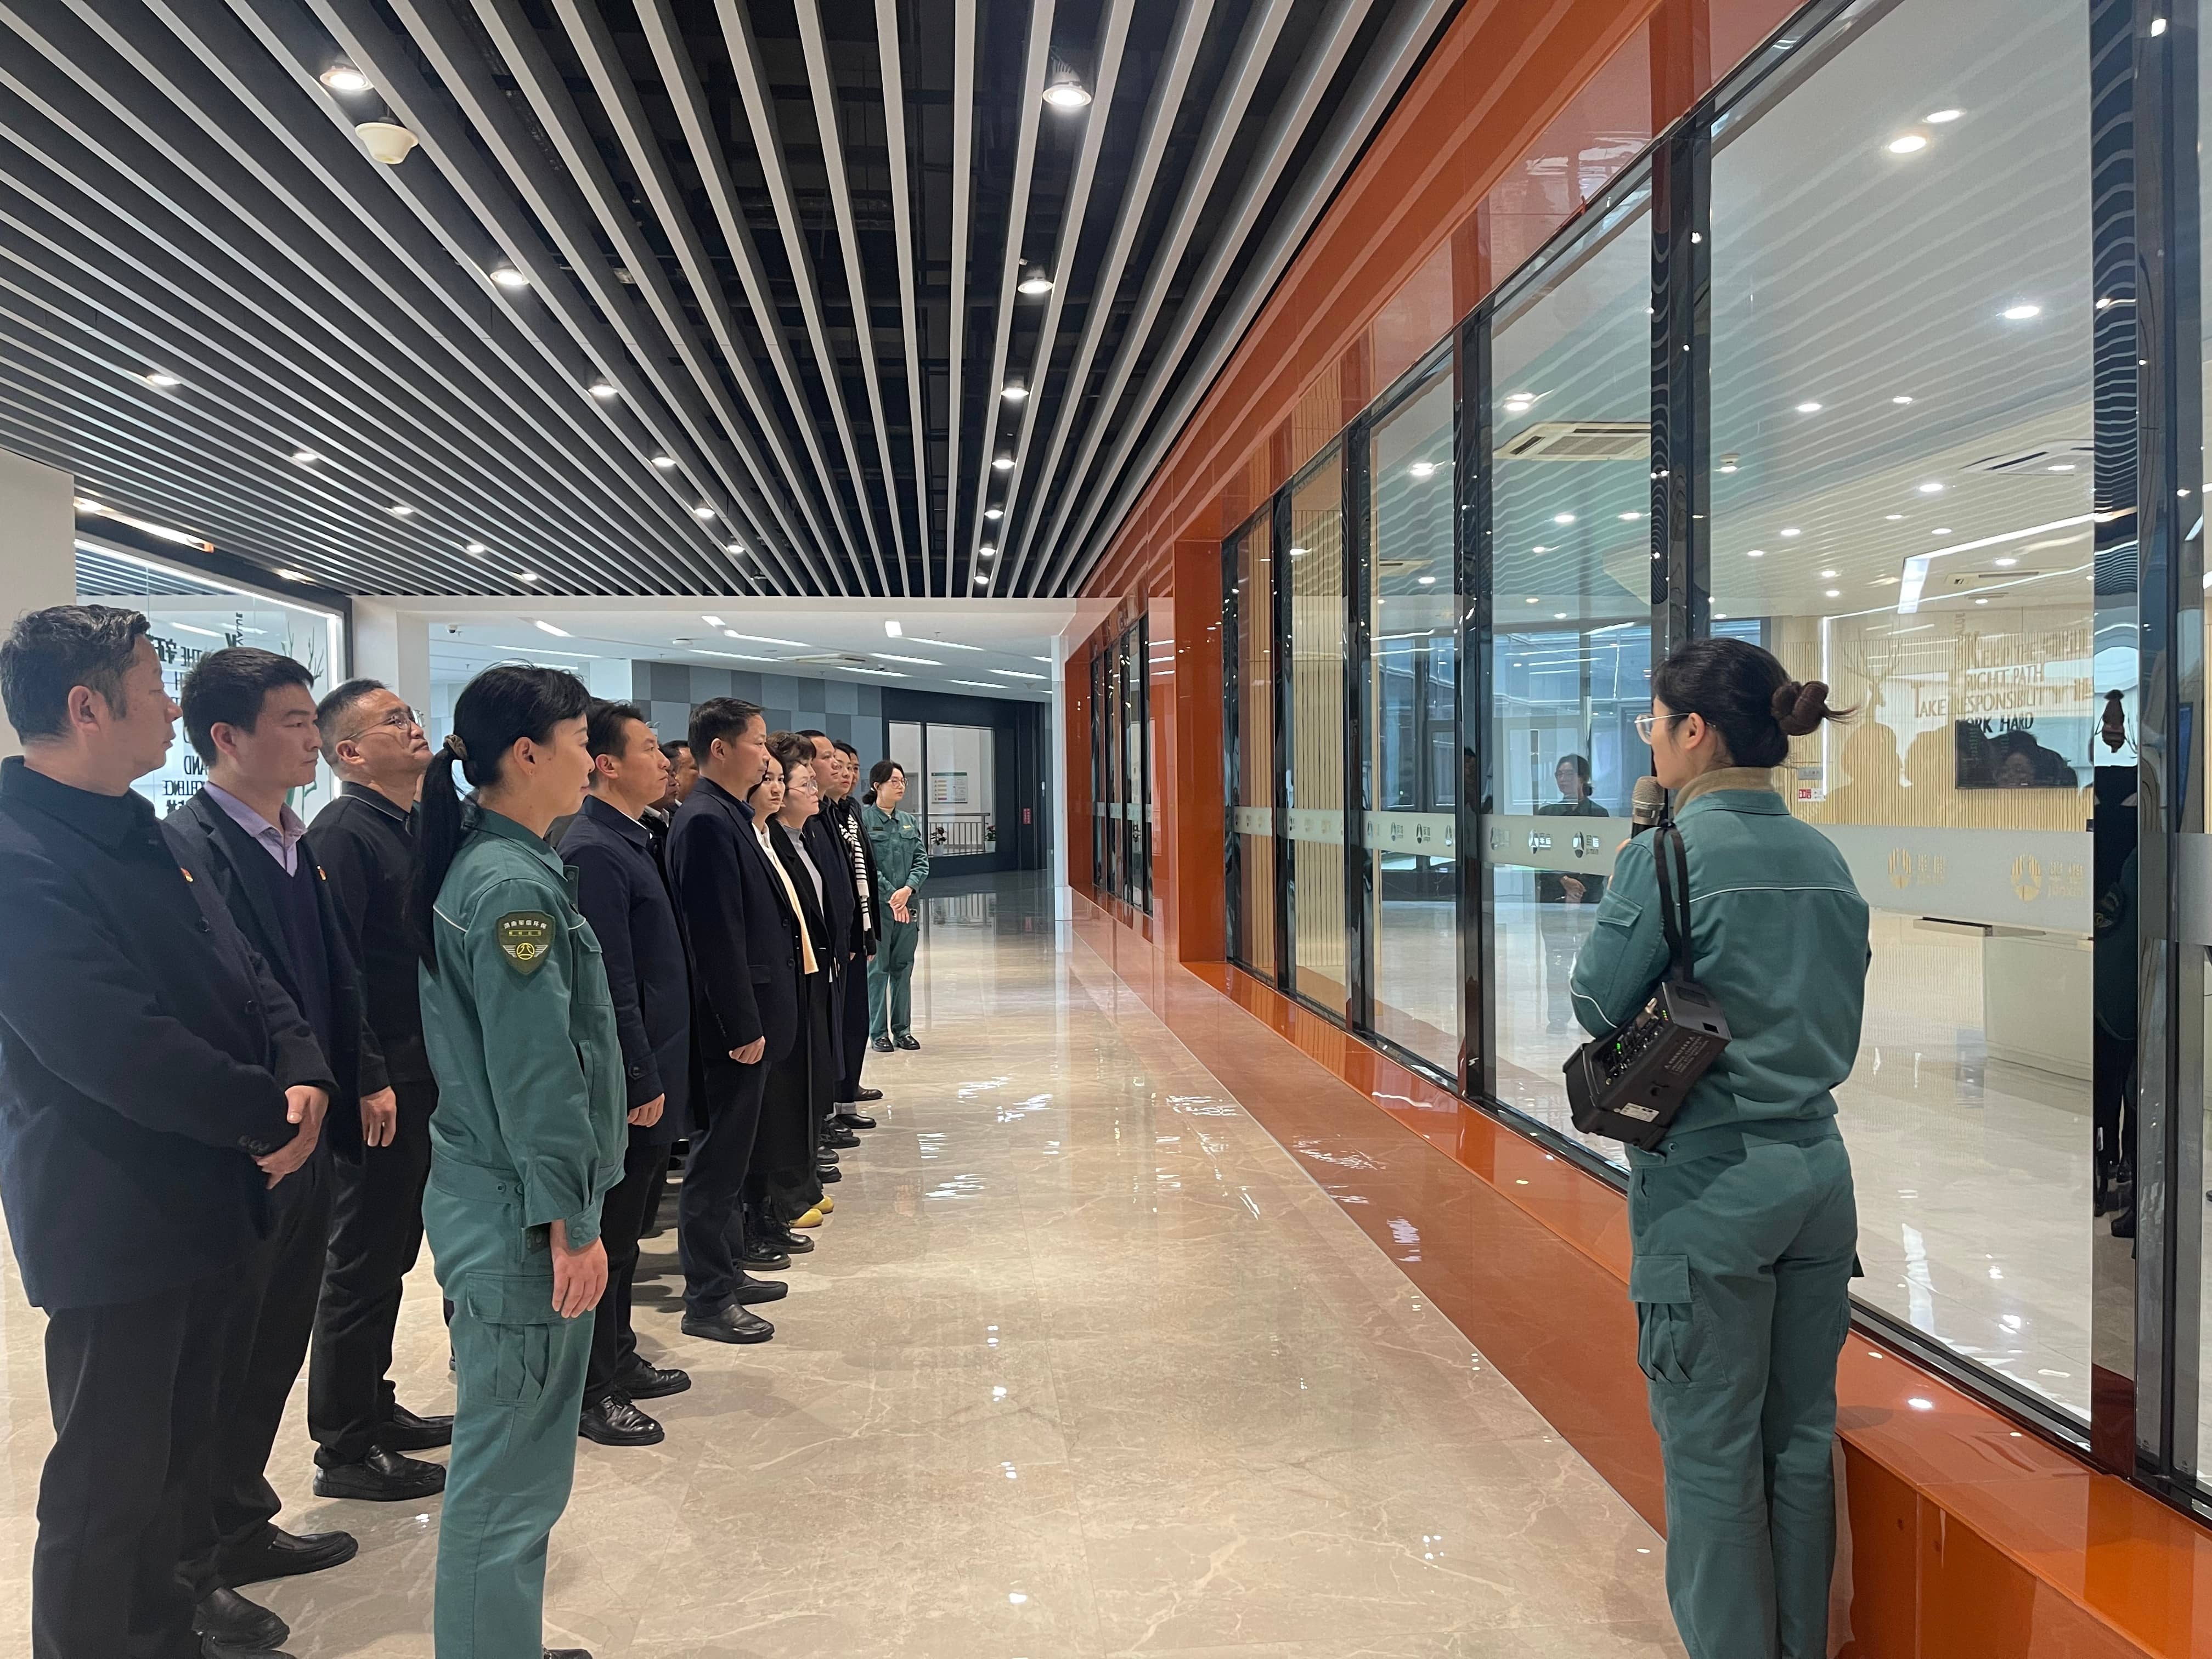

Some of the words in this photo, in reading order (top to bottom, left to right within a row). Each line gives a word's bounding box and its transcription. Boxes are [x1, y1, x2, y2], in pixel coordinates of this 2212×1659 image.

[2013, 663, 2045, 684] PATH
[1910, 680, 1947, 718] TAKE
[2000, 712, 2034, 732] HARD
